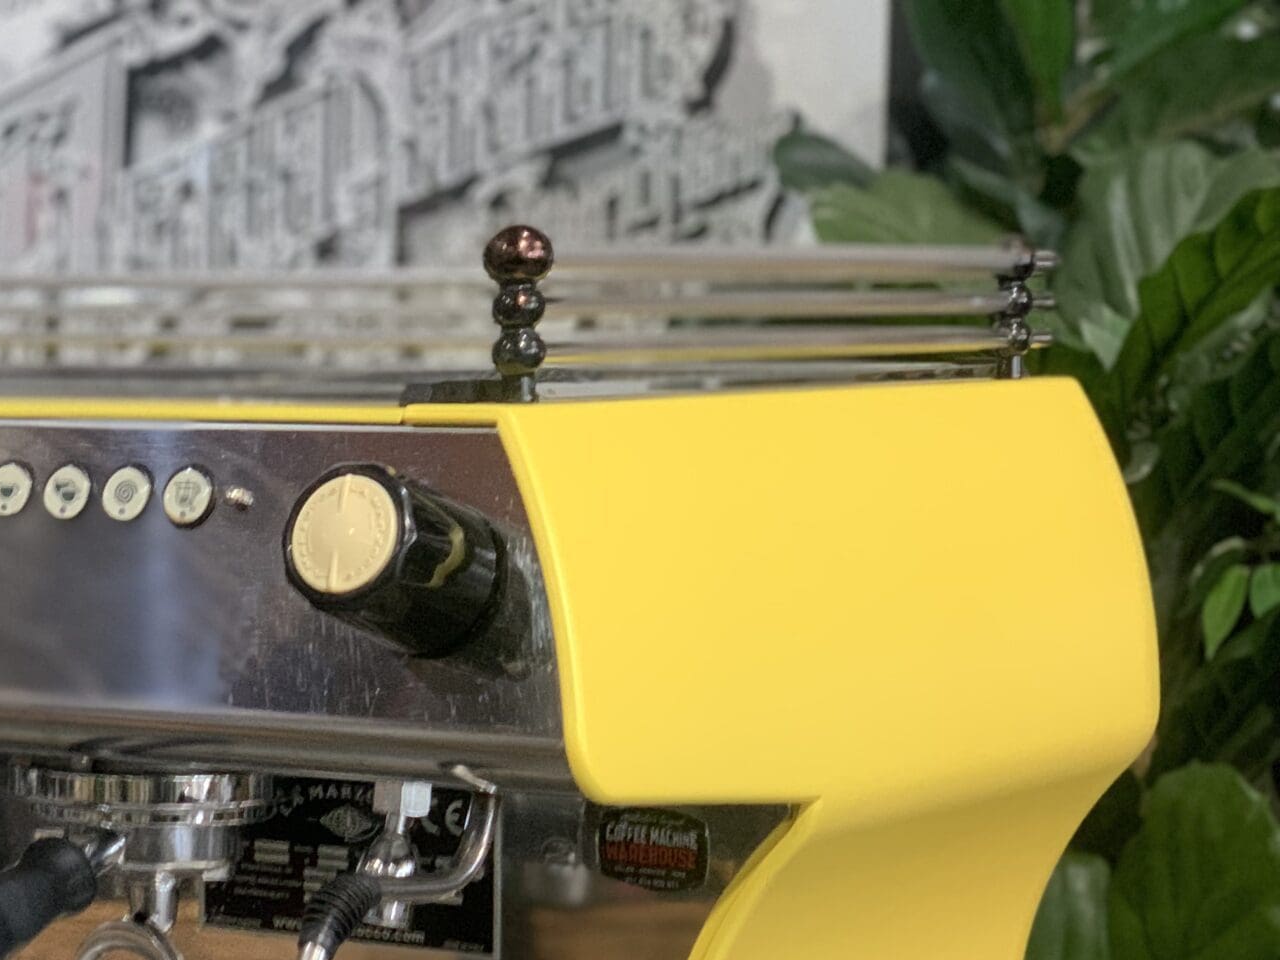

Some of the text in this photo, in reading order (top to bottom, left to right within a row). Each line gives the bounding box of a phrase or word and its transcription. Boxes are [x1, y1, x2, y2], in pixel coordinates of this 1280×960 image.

[606, 821, 698, 851] COFFEE MACHINE
[605, 841, 698, 871] WAREHOUSE
